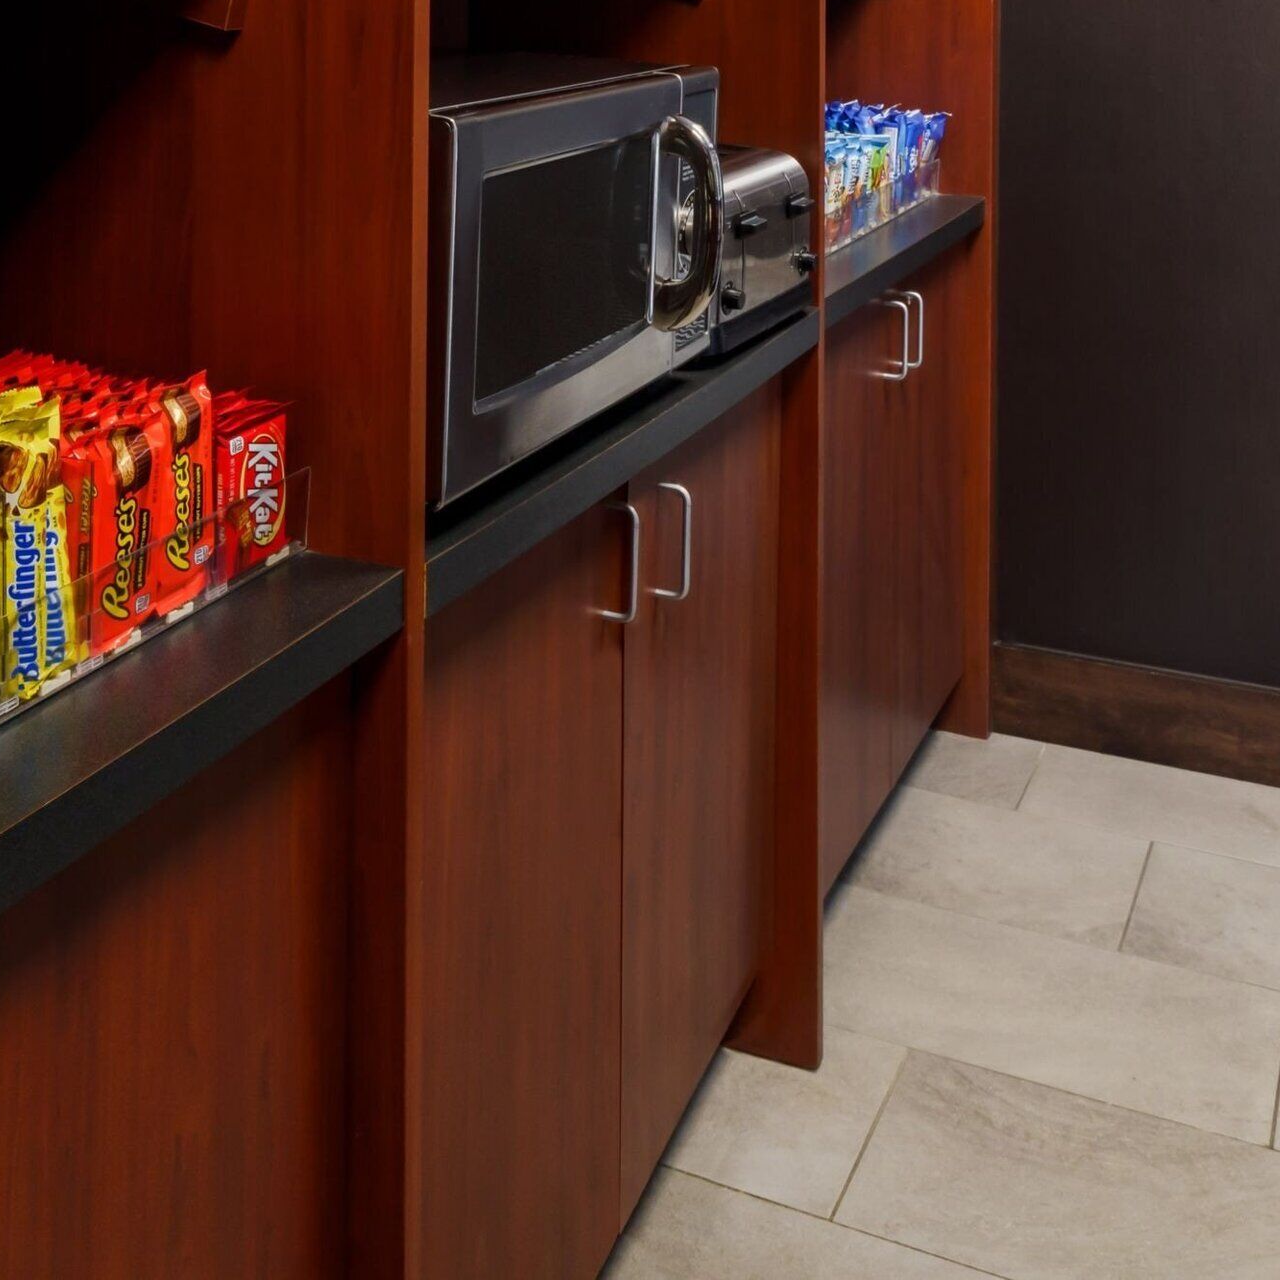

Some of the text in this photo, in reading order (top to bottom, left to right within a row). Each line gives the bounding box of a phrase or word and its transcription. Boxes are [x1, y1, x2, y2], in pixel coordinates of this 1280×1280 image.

[101, 496, 138, 620] Reese's
[166, 452, 191, 571] Reese's
[7, 519, 41, 684] Butterfinger
